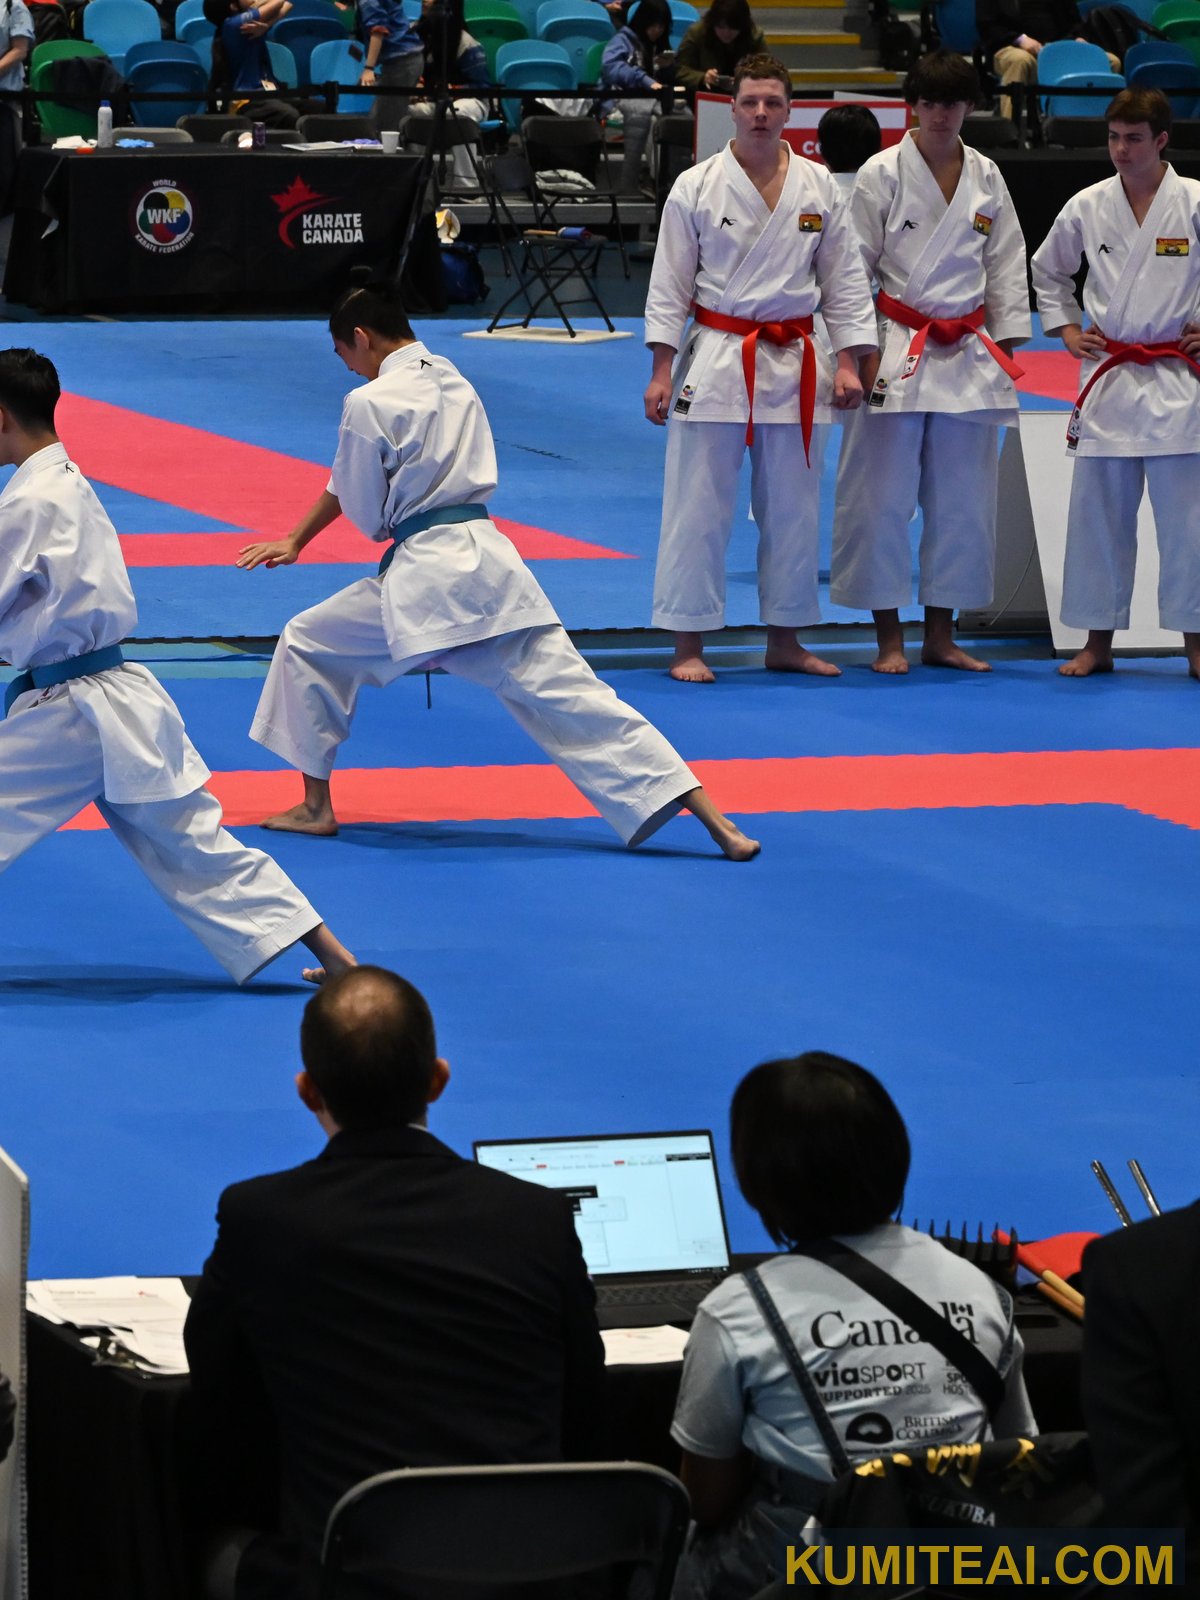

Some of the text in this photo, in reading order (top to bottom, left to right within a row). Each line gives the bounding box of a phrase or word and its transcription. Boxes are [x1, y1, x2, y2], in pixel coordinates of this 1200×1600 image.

[152, 178, 177, 187] WORLD
[146, 207, 182, 225] WKF
[302, 213, 363, 229] KARATE
[159, 231, 195, 254] FEDERATION
[302, 228, 365, 245] CANADA
[811, 1301, 979, 1350] Canaa
[813, 1362, 927, 1387] viaSPORT
